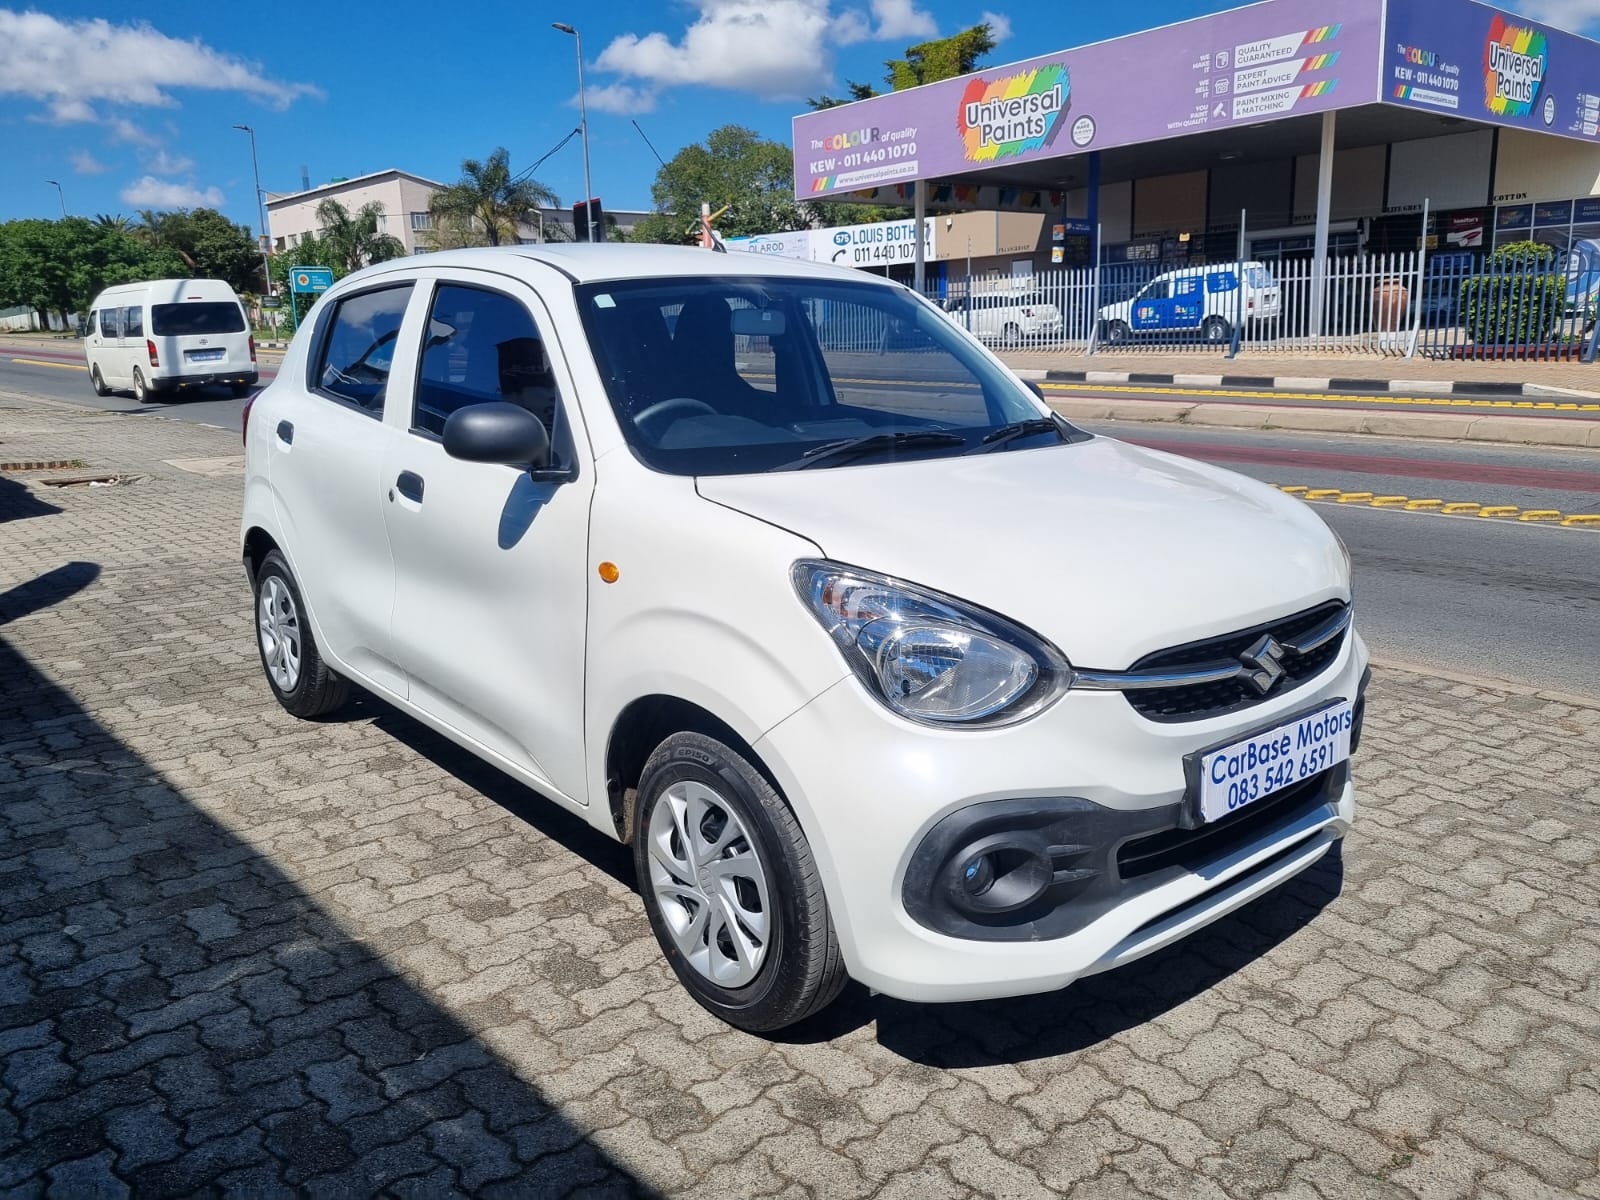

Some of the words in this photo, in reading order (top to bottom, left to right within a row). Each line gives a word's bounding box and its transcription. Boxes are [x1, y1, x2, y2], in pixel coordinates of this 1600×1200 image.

[1237, 47, 1293, 64] GUARANTEED
[1239, 43, 1271, 56] QUALITY
[1490, 43, 1542, 79] Universal
[1237, 69, 1267, 82] EXPERT
[1237, 78, 1259, 89] PAINT
[1261, 73, 1291, 85] ADVICE
[1394, 65, 1412, 80] KEW
[1417, 72, 1428, 84] 011
[1429, 73, 1442, 87] 440
[1442, 76, 1459, 91] 1070
[1497, 72, 1532, 100] Paints
[966, 86, 1060, 125] Universal
[1236, 97, 1259, 108] PAINT
[1260, 91, 1290, 103] MIXING
[1242, 101, 1284, 115] MATCHING
[981, 115, 1044, 145] Paints
[1183, 117, 1208, 127] QUALITY
[810, 139, 823, 150] The
[824, 126, 880, 152] COLOUR
[881, 131, 890, 143] of
[890, 127, 918, 142] quality
[810, 158, 836, 174] KEW
[844, 153, 861, 168] 011
[863, 150, 886, 163] 440
[888, 142, 917, 159] 1070
[1494, 192, 1528, 201] COTTON
[852, 227, 883, 245] LOUIS
[855, 247, 870, 262] 011
[873, 245, 895, 261] 440
[898, 241, 931, 259] 1071
[1211, 735, 1291, 784] CarBase
[1297, 709, 1352, 750] Motors
[1228, 773, 1258, 809] 083
[1264, 759, 1294, 793] 542
[1299, 741, 1334, 778] 6591
